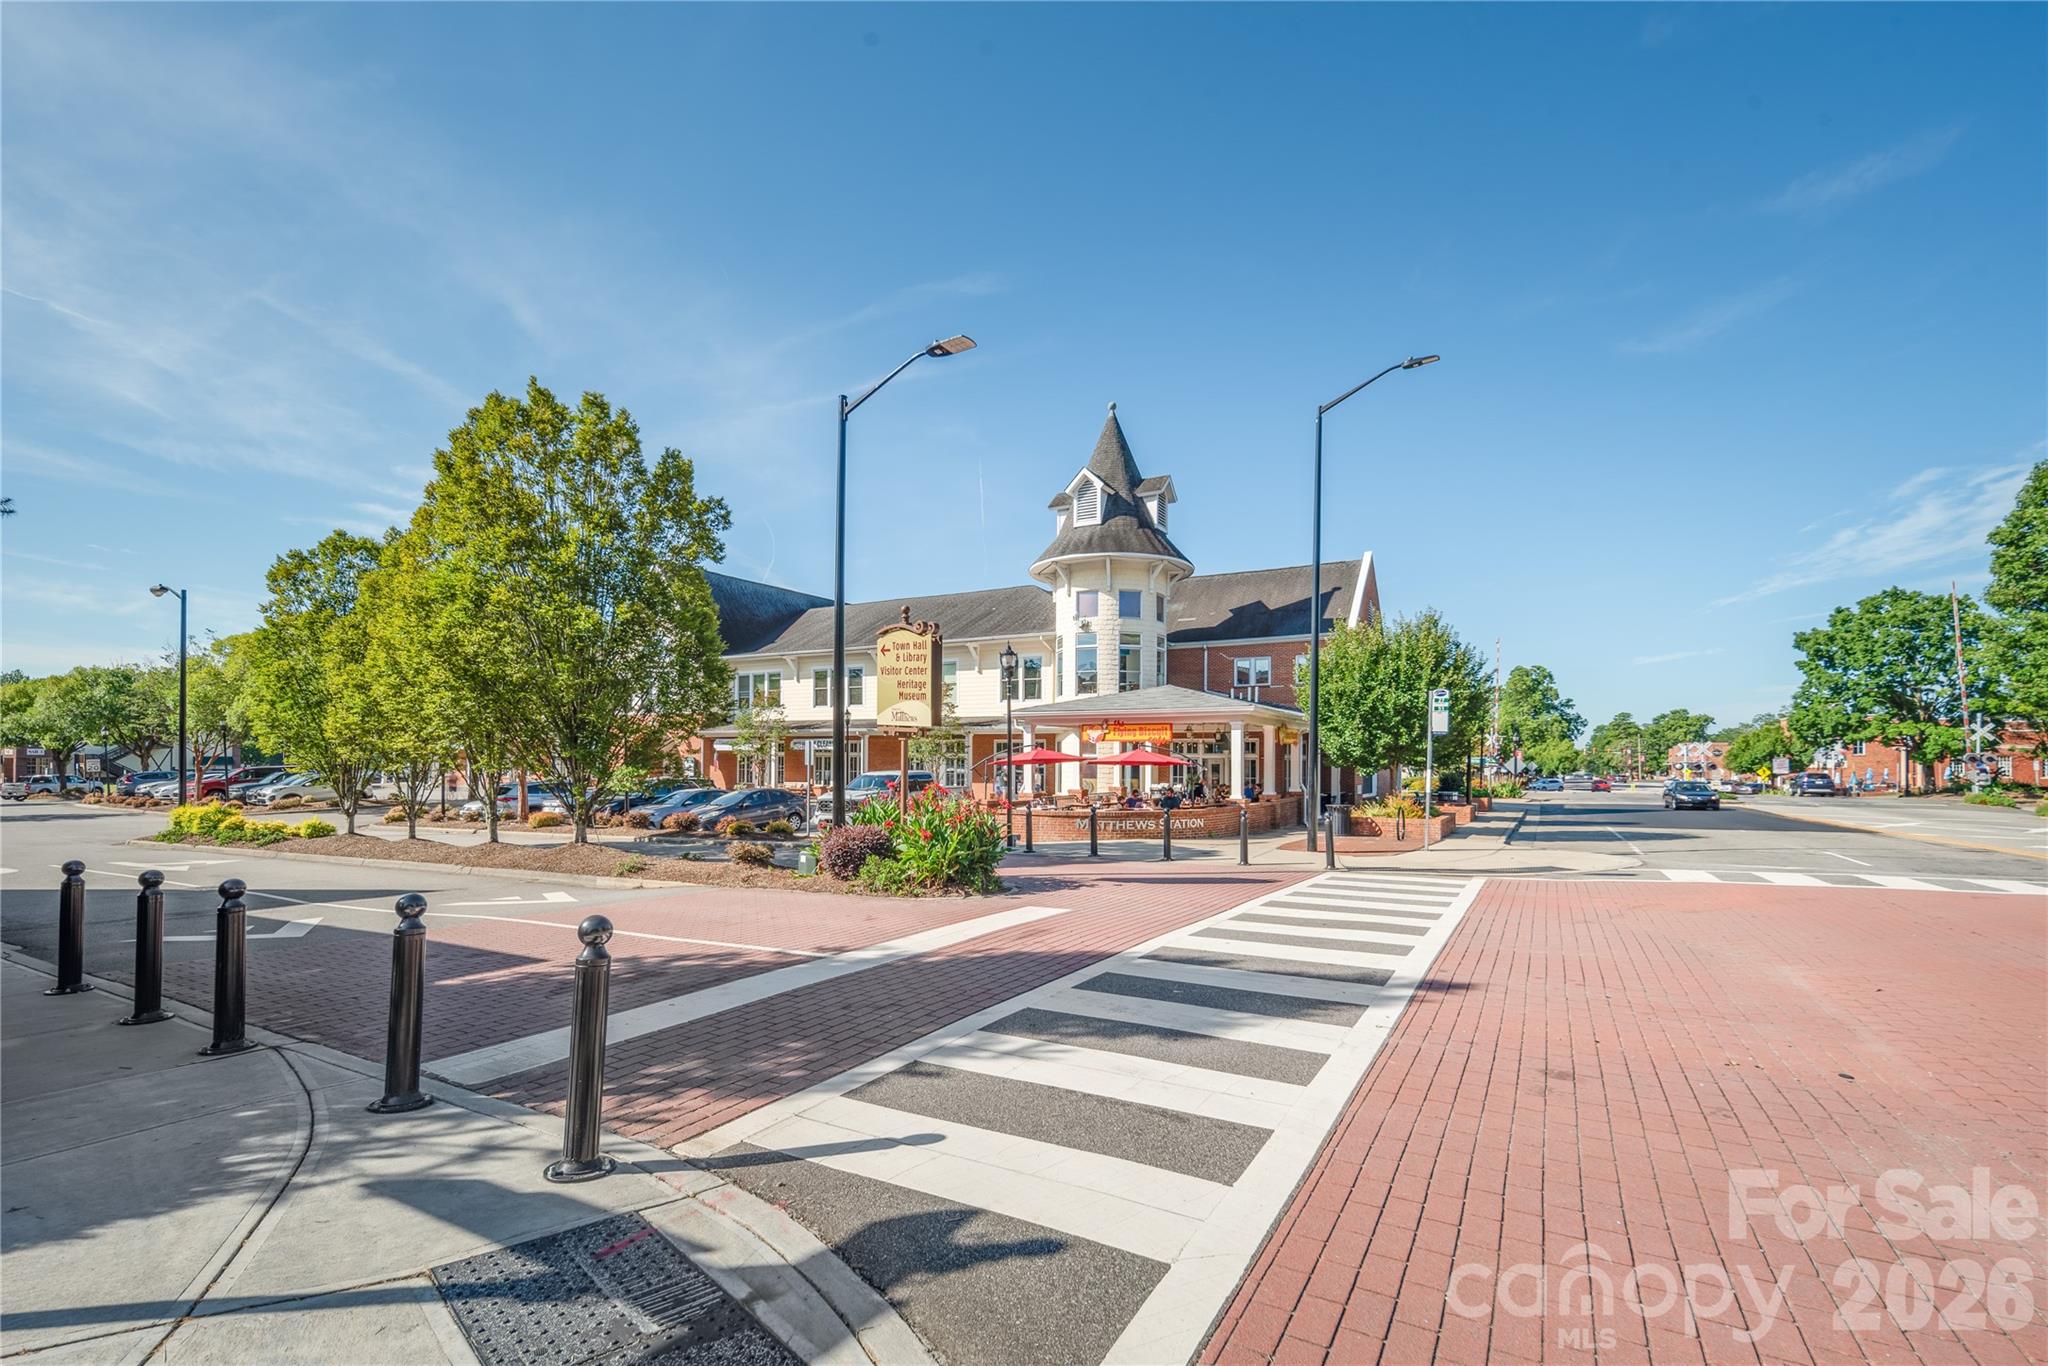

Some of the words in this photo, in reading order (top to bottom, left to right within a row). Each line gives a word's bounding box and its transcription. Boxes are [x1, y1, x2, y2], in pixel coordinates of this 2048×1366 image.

[892, 641, 910, 650] Town
[913, 641, 927, 650] Hall
[895, 653, 900, 662] &
[903, 653, 927, 664] Library
[880, 667, 902, 676] Visitor
[904, 666, 927, 675] Center
[897, 680, 927, 690] Heritage
[899, 692, 926, 700] Museum
